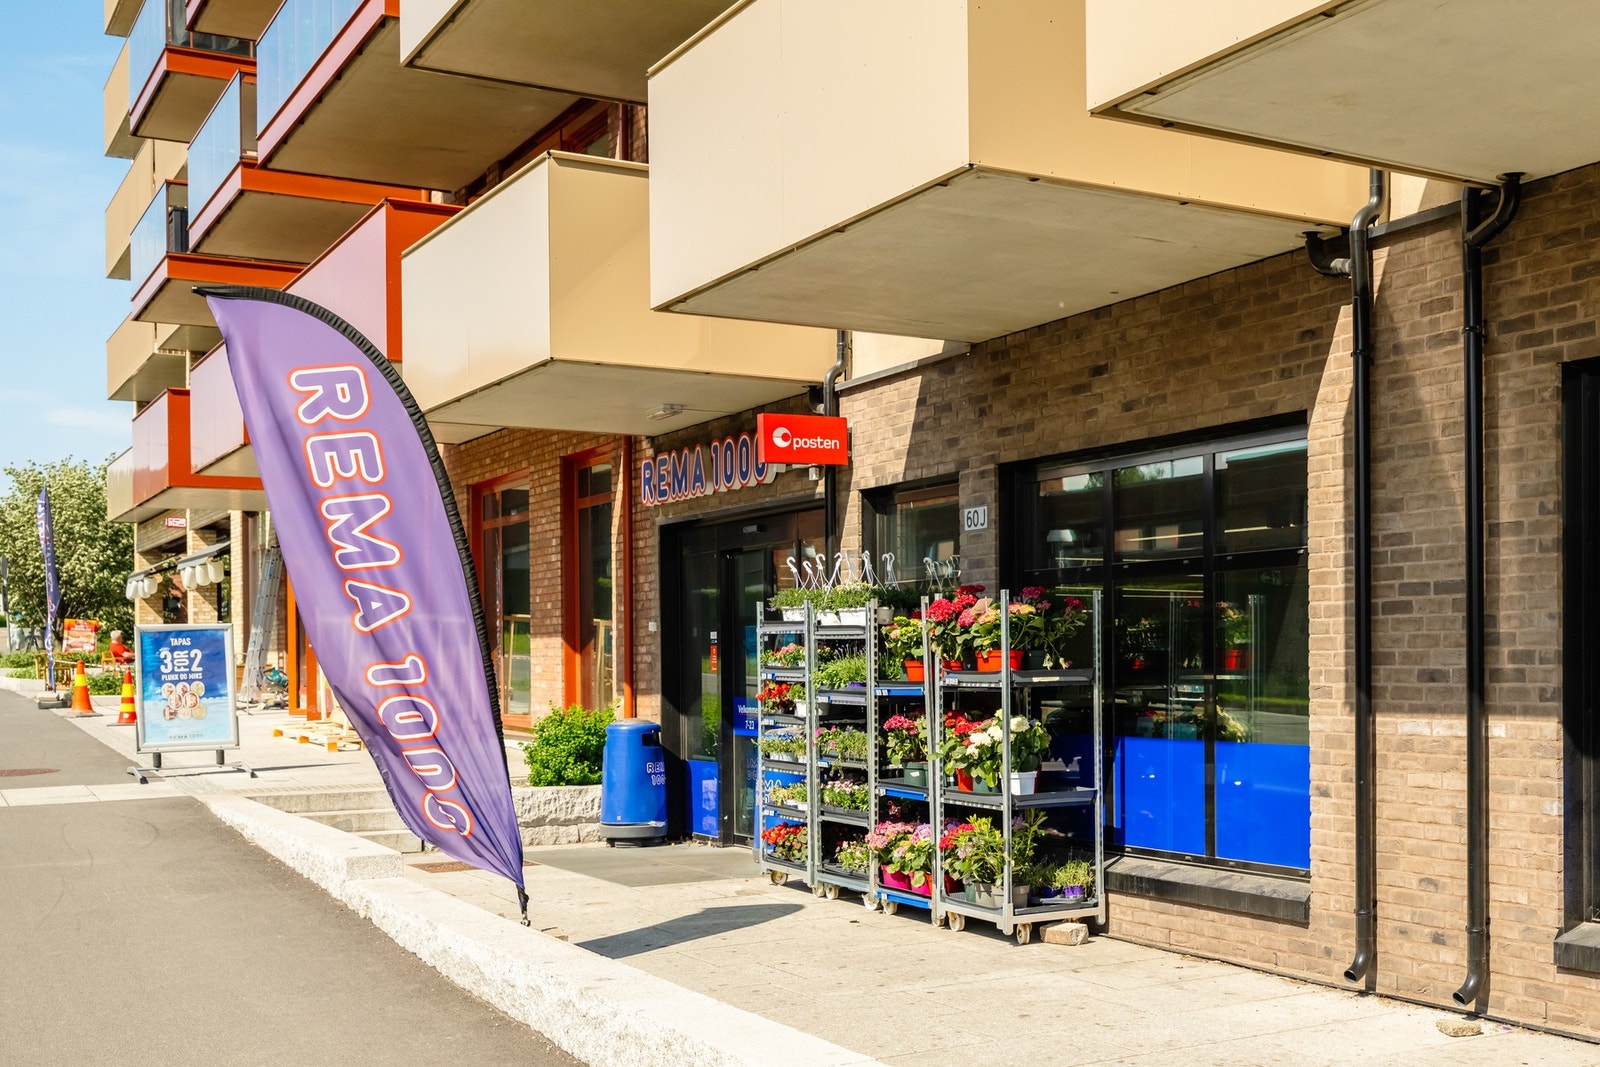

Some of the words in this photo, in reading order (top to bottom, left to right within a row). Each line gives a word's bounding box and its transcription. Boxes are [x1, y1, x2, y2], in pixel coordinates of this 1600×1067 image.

[793, 436, 840, 450] posten
[641, 443, 705, 507] REMA
[289, 364, 413, 635] REMA
[966, 508, 986, 528] 60J
[170, 637, 191, 646] TAPAS
[160, 650, 172, 673] 3
[173, 650, 190, 672] FOR
[190, 648, 203, 672] 2
